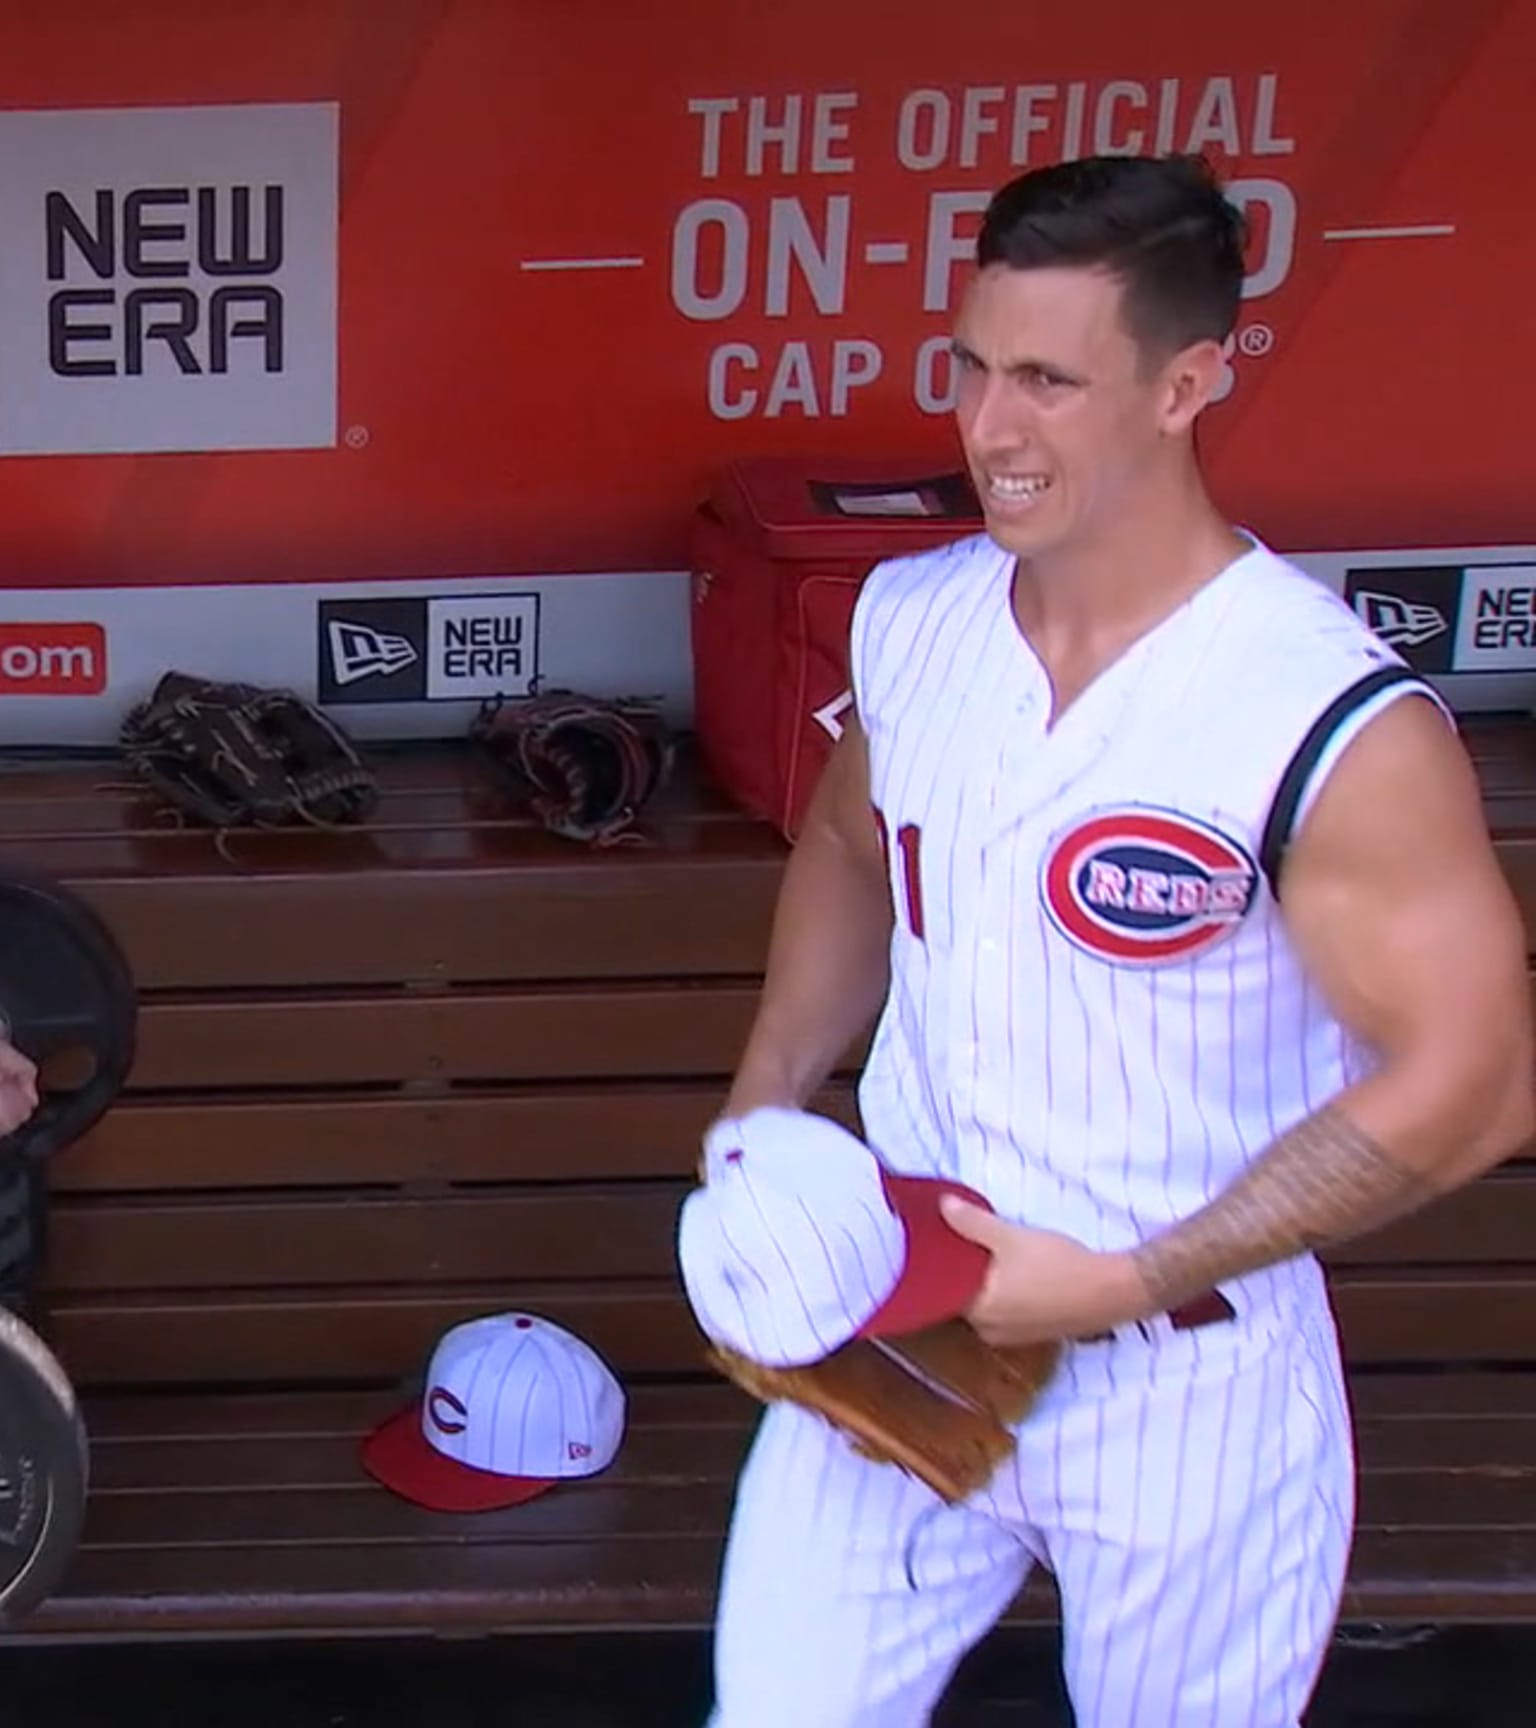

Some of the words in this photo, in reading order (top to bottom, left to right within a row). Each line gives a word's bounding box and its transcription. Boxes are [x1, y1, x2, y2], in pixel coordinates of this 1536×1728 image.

[688, 93, 858, 178] THE
[897, 74, 1295, 171] OFFICIAL
[45, 185, 283, 281] NEW
[671, 178, 1296, 321] ON-FD
[48, 285, 283, 377] ERA
[708, 339, 883, 420] CAP
[444, 649, 522, 678] ERA
[445, 616, 522, 647] NEW
[1086, 859, 1251, 916] REDS
